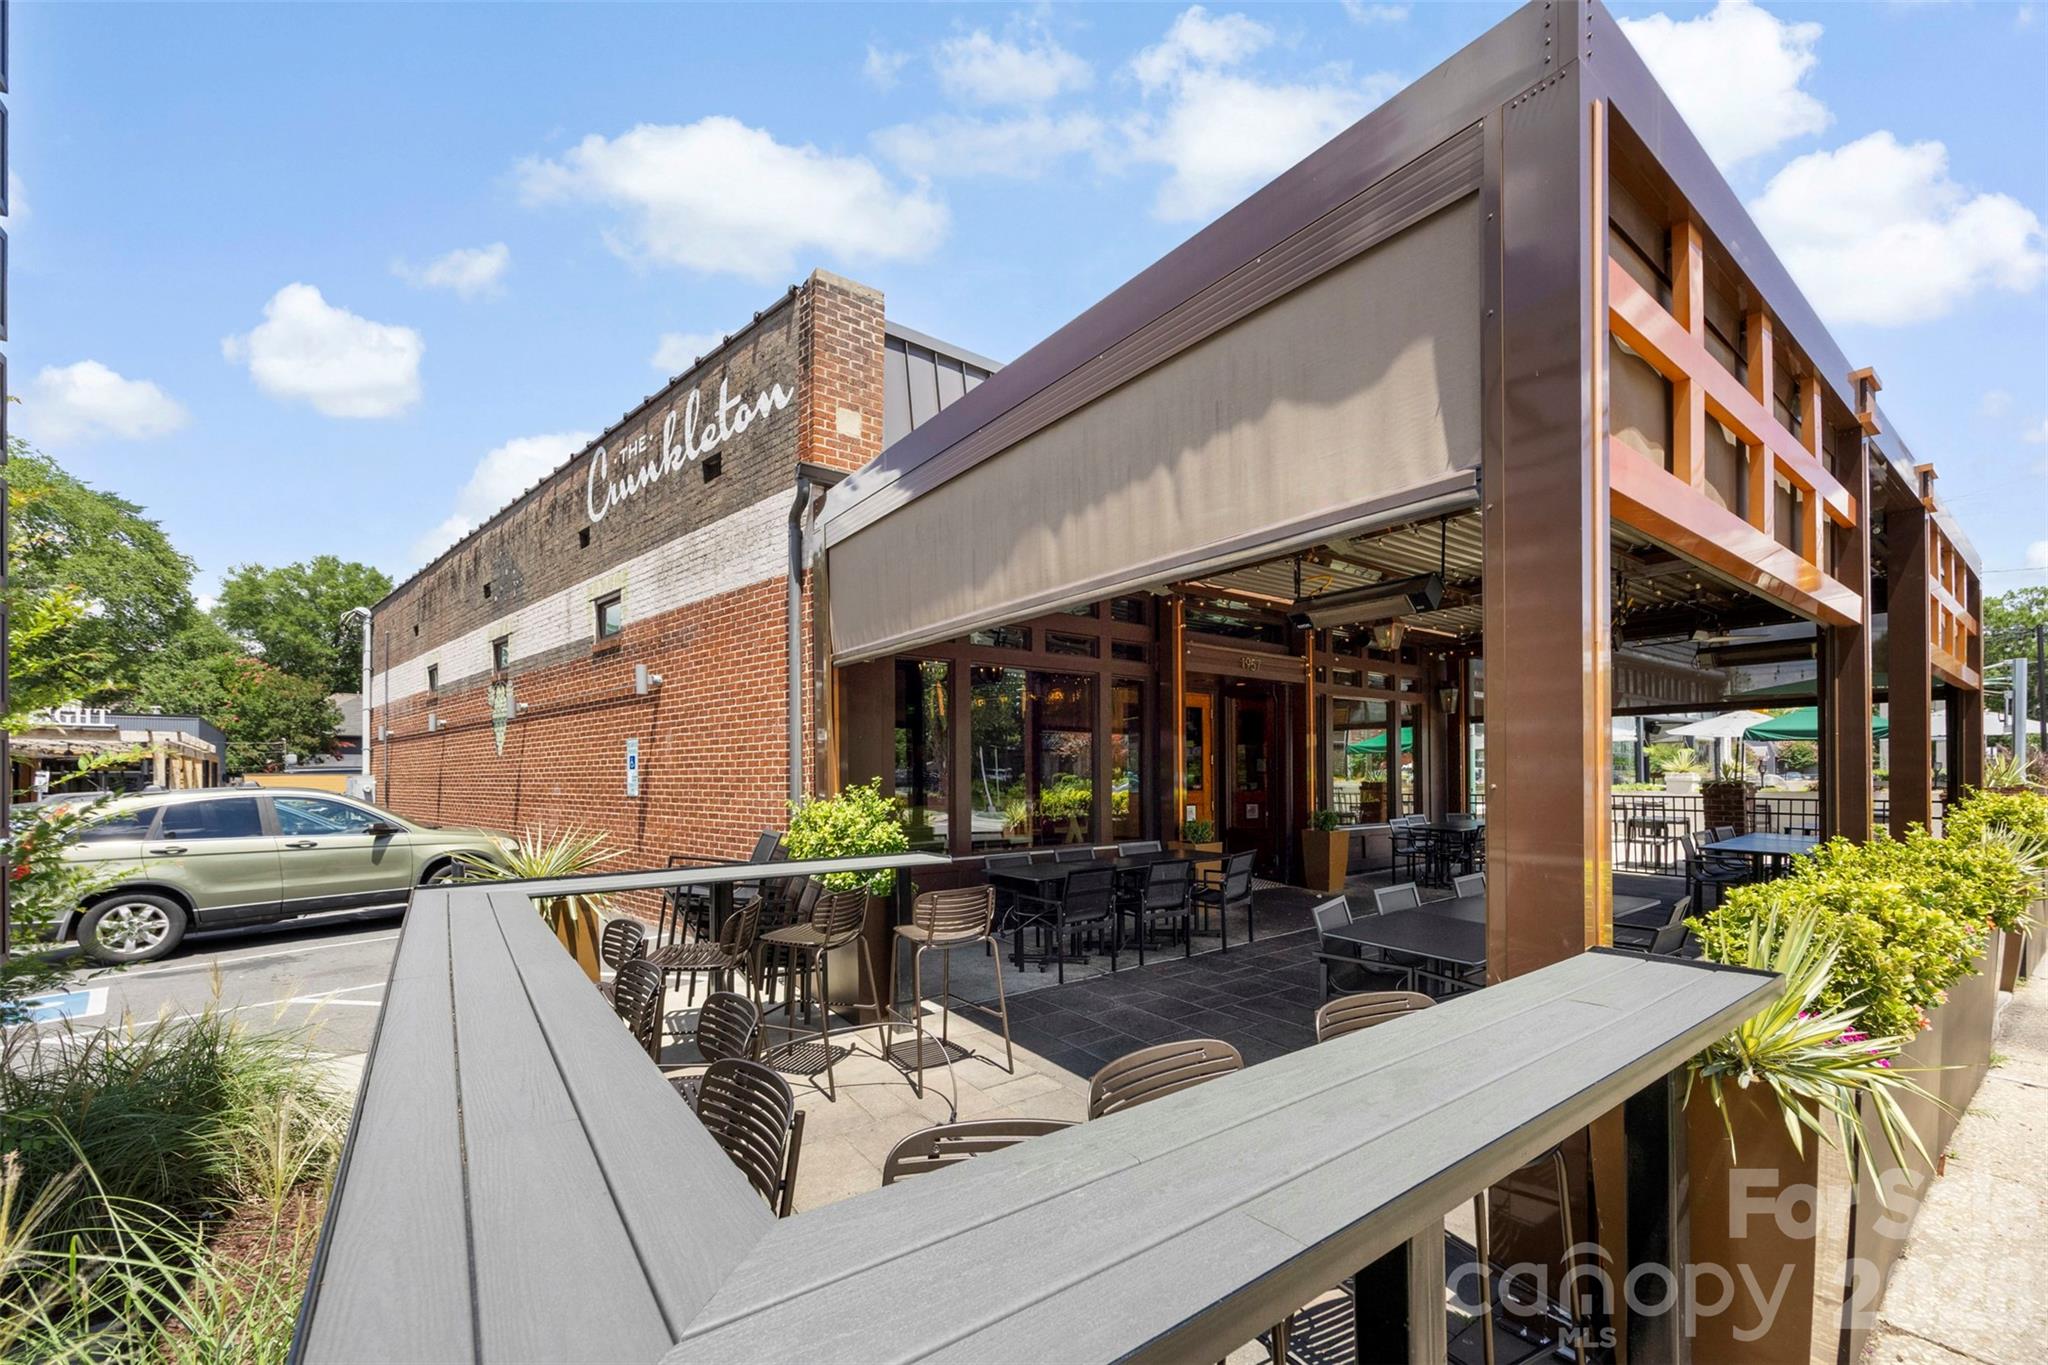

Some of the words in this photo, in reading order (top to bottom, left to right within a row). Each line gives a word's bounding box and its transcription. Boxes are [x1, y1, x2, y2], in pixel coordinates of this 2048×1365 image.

[587, 377, 794, 523] Crunkleton
[619, 435, 647, 463] THE
[1241, 656, 1262, 671] 1957
